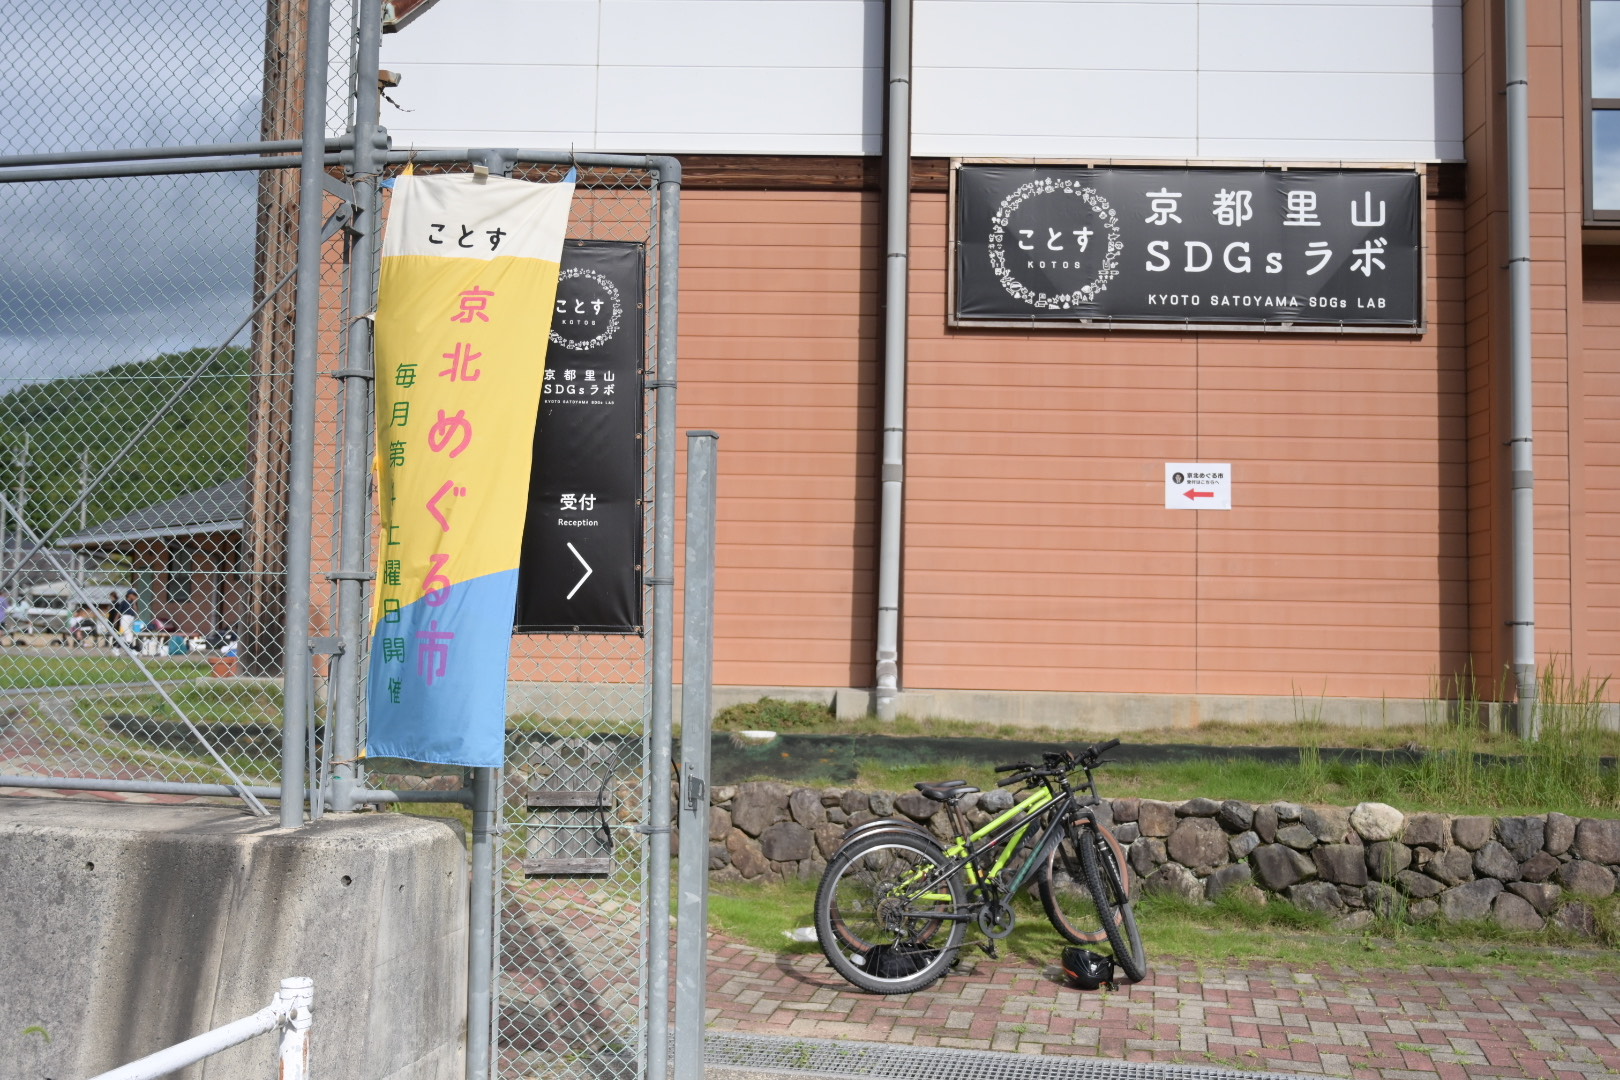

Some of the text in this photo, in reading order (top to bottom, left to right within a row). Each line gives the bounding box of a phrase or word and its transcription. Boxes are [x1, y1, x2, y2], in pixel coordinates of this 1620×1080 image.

[1145, 187, 1386, 227] 京都里山
[429, 223, 507, 251] ことす
[1018, 226, 1094, 253] ことす
[1027, 260, 1081, 269] KOTOS
[1145, 237, 1388, 277] SDGsラボ
[556, 298, 605, 315] ことす
[1148, 294, 1386, 309] KYOTO SATOYAMA SDGs LAB
[544, 368, 615, 382] 京都里山
[544, 383, 615, 396] SDGsラボ
[415, 285, 495, 687] 京北めぐる市
[560, 493, 597, 511] 受付
[558, 518, 599, 527] Reception
